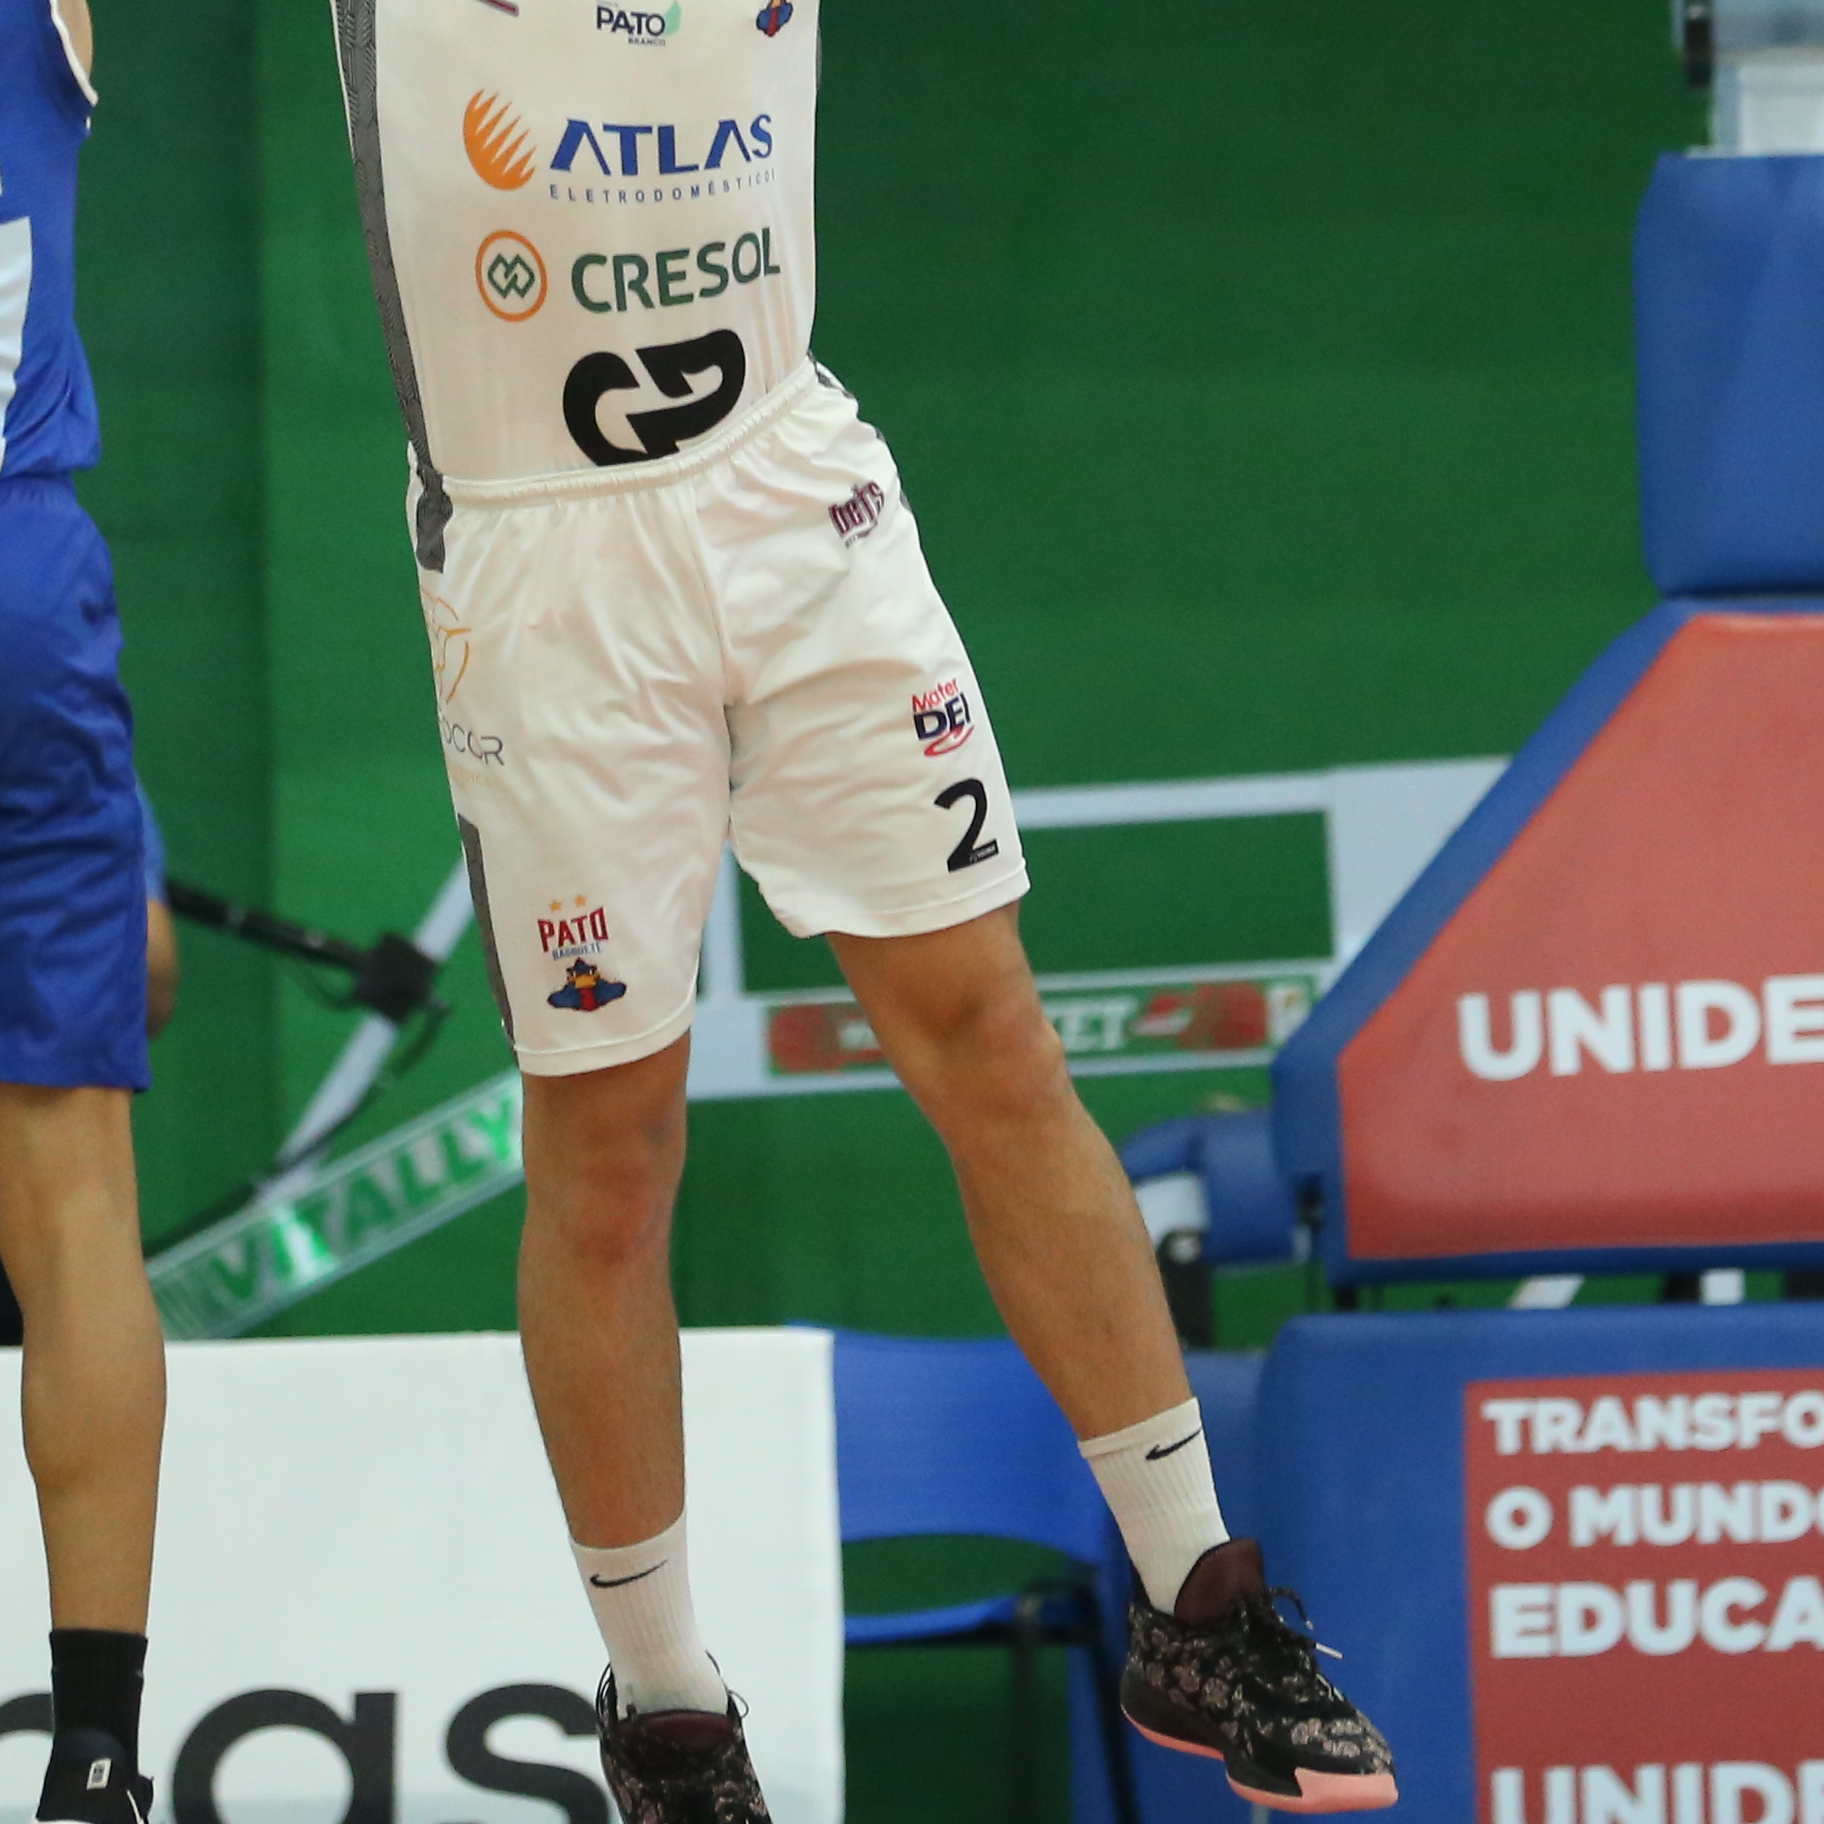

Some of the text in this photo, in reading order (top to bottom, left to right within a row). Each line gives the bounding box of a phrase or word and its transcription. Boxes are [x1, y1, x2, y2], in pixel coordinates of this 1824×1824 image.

[596, 5, 667, 37] PATO
[549, 114, 773, 177] ATLAS
[570, 227, 781, 314] CRESOL
[911, 678, 959, 713] Mater
[913, 691, 972, 740] DEI
[934, 778, 1000, 873] 2
[537, 906, 609, 953] PATO
[1486, 1487, 1552, 1549] O
